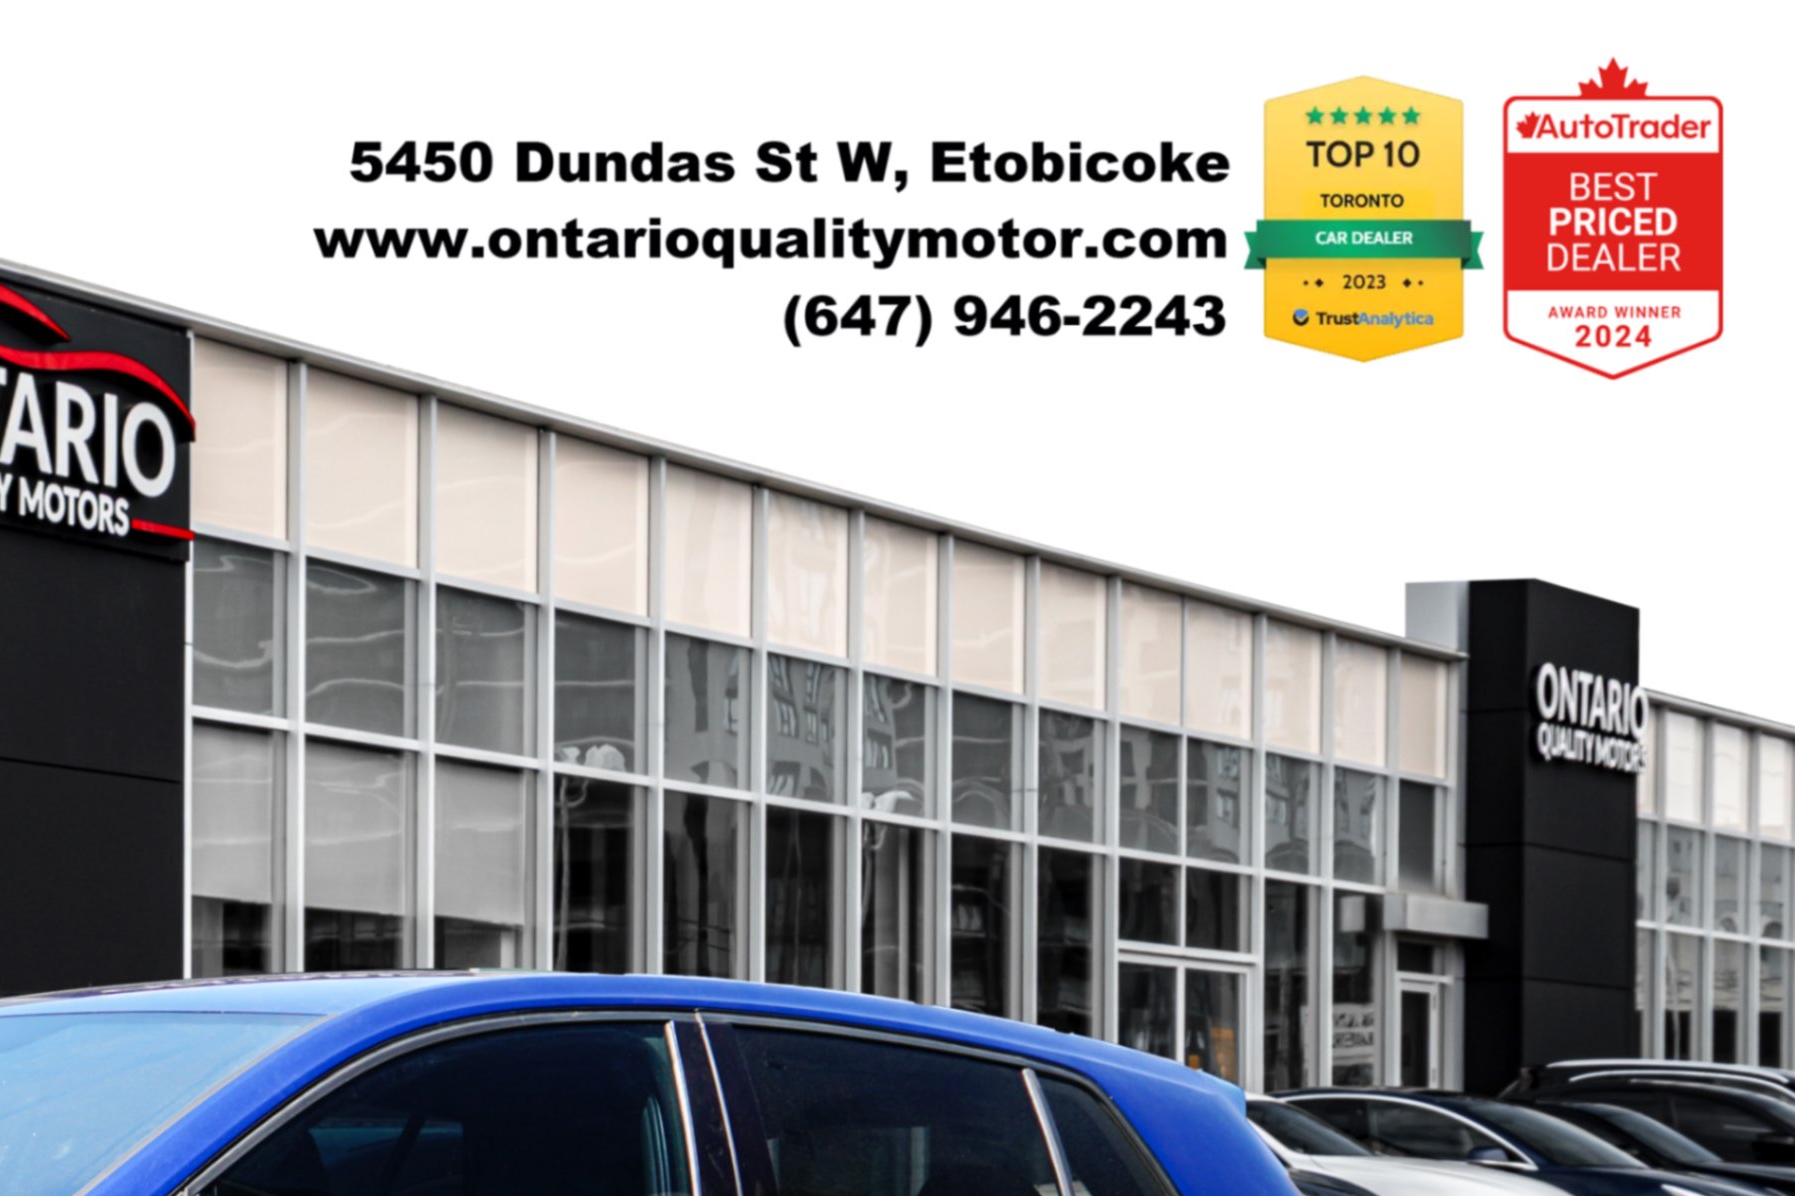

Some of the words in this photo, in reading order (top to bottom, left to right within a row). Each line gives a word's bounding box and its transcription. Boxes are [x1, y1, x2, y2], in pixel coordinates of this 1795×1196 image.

[18, 476, 131, 537] MOTORS
[1536, 661, 1649, 739] ONTARIO
[1536, 721, 1594, 762] QUALITY
